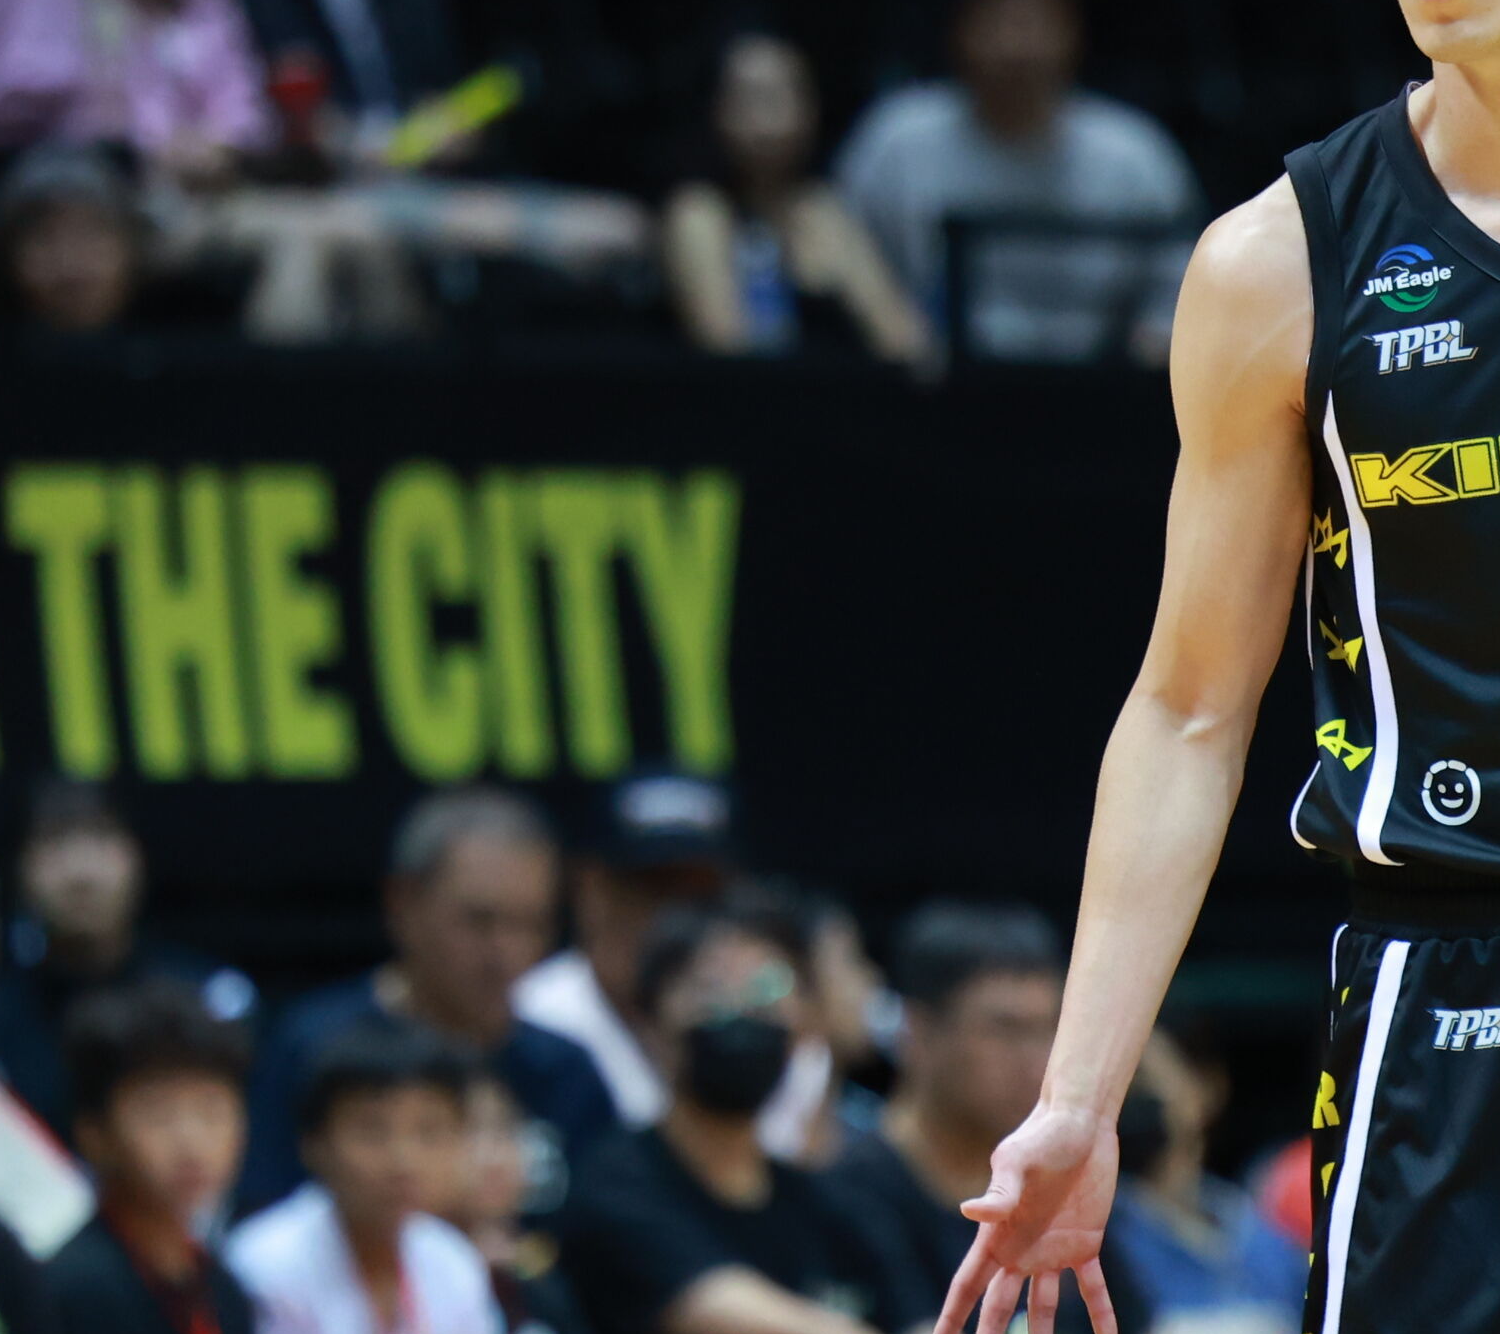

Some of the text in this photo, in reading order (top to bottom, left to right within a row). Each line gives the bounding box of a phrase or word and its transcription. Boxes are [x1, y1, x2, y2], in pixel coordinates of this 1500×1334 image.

[1363, 266, 1452, 296] JM Eagle
[1365, 320, 1478, 375] TPBL
[5, 462, 359, 780] THE
[368, 462, 742, 782] CITY
